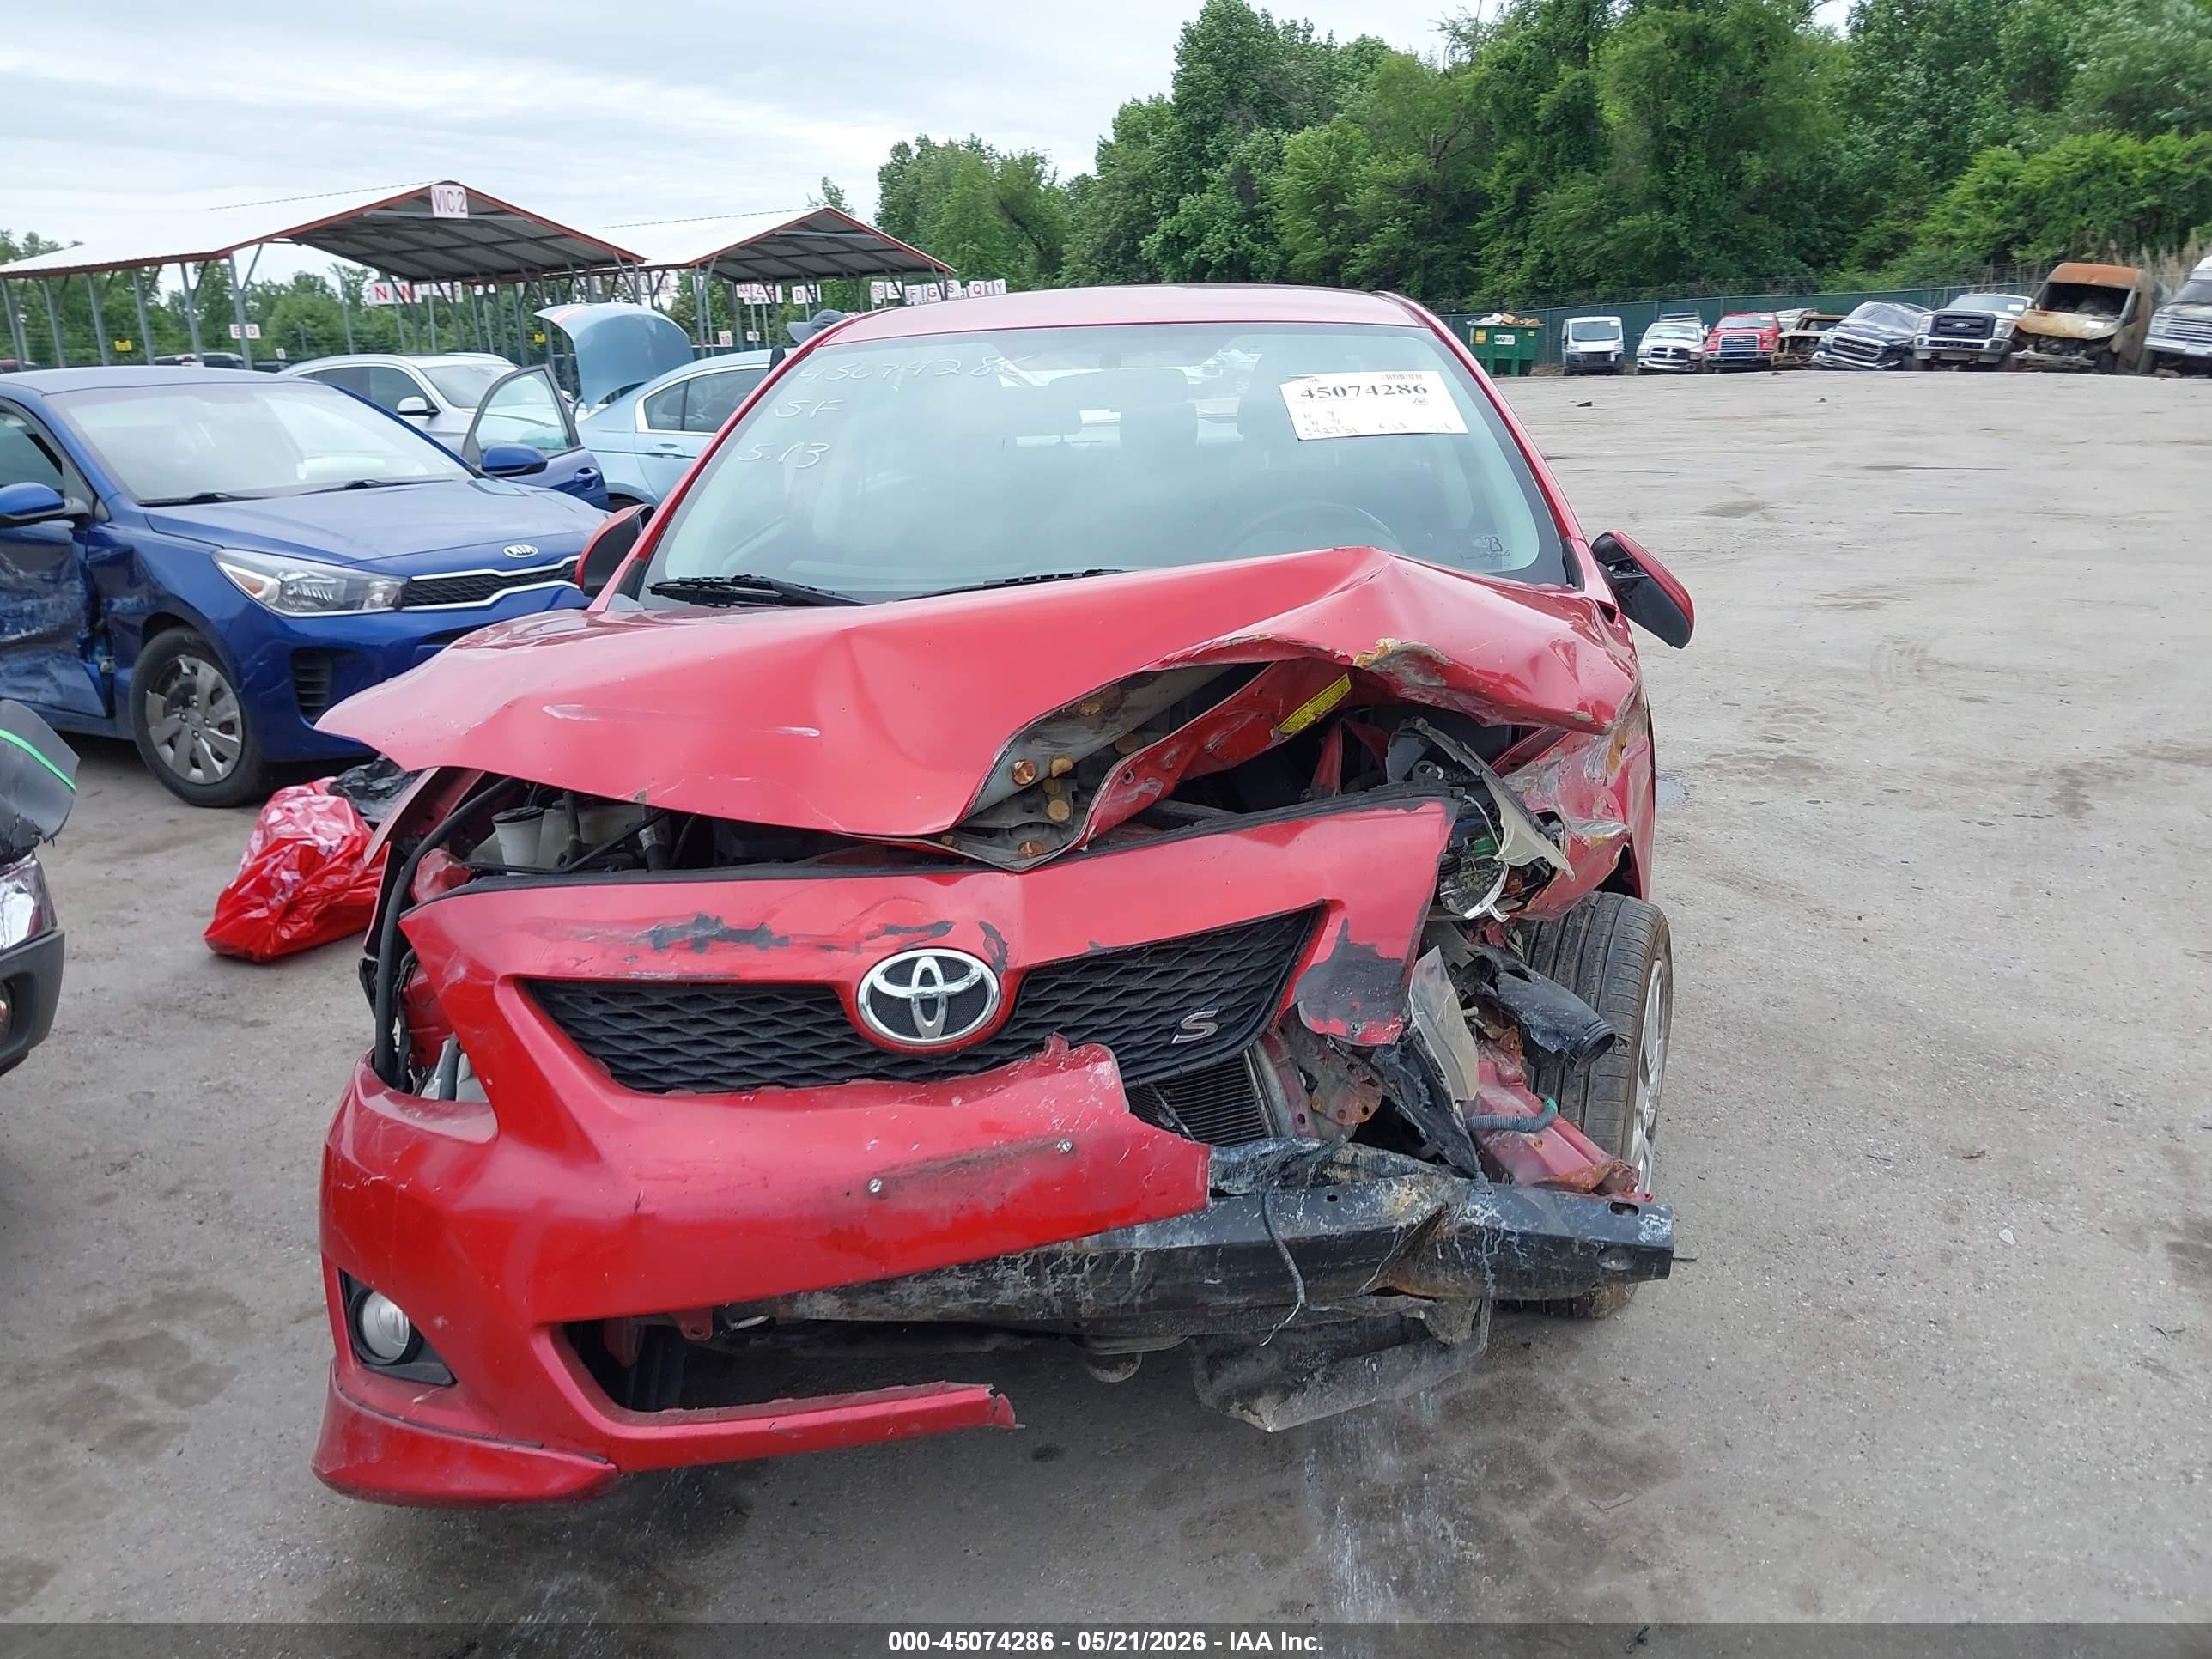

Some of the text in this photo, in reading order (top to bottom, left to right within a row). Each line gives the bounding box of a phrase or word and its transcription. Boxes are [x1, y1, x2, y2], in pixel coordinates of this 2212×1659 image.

[432, 190, 467, 213] VIC 2
[374, 286, 388, 301] N
[927, 288, 937, 298] G
[946, 283, 955, 293] S
[973, 283, 982, 295] Q
[995, 283, 1003, 293] Y
[1300, 382, 1429, 399] 45074286
[774, 398, 845, 419] SF
[1170, 1007, 1218, 1044] S
